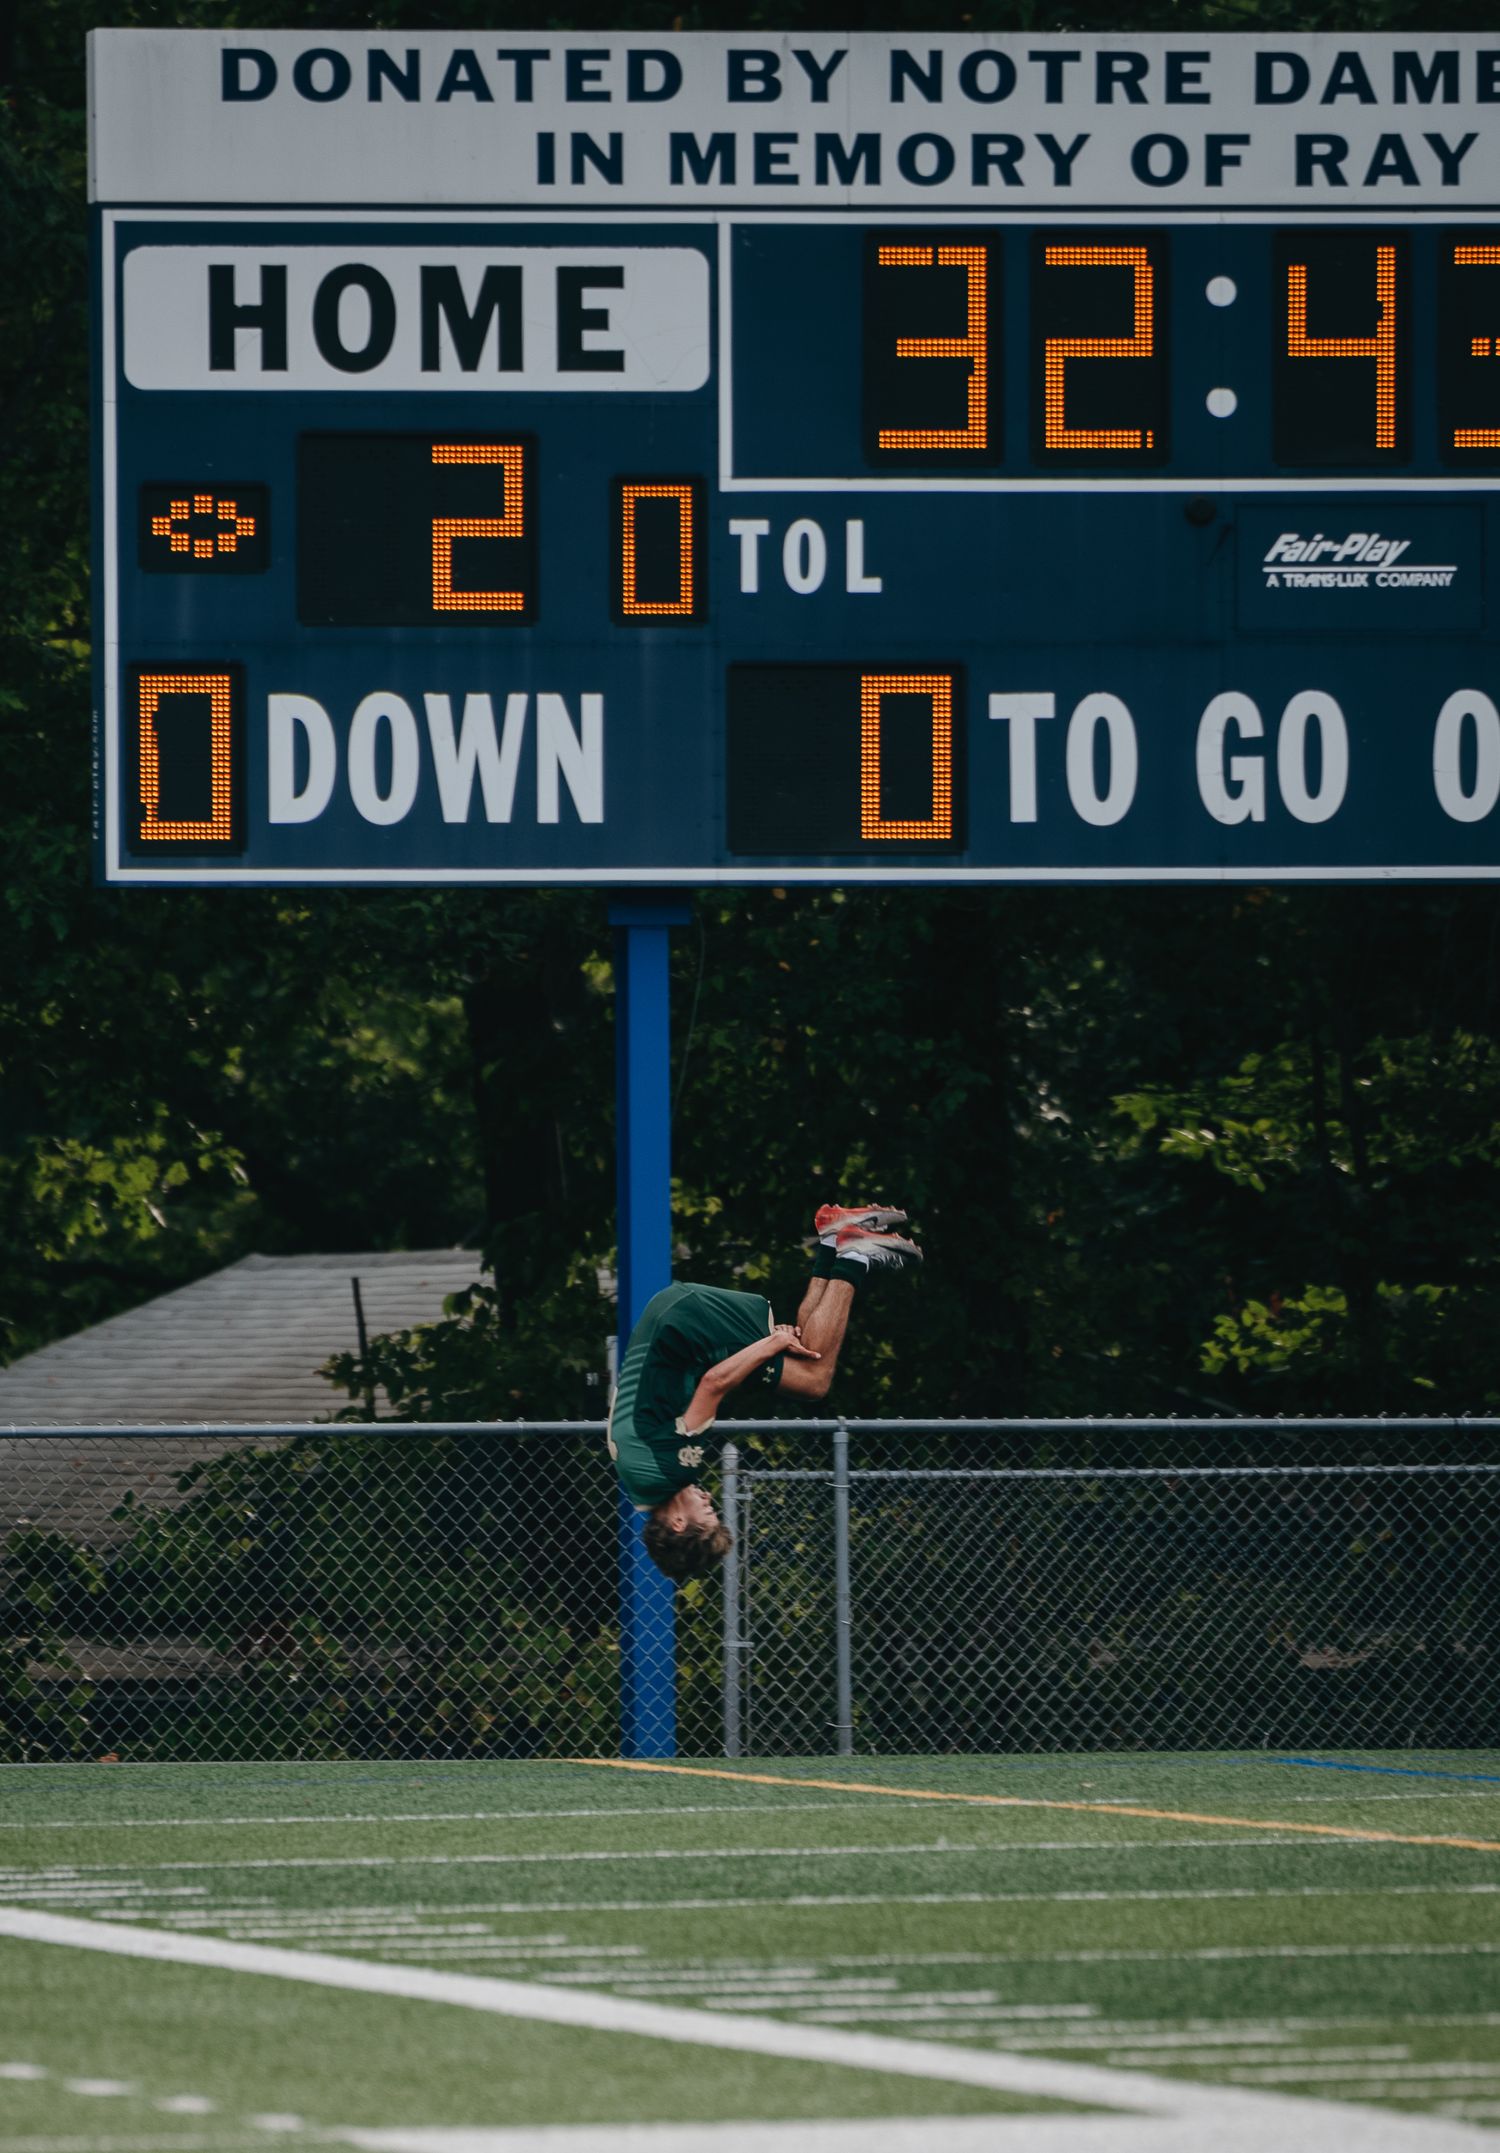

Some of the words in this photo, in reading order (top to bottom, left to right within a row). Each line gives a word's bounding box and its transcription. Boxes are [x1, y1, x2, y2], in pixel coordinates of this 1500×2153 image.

[222, 48, 682, 102] DONATED
[728, 50, 848, 102] BY
[891, 50, 1210, 104] NOTRE
[538, 132, 623, 184] IN
[670, 133, 1090, 186] MEMORY
[1131, 134, 1250, 187] OF
[1296, 133, 1478, 186] RAY
[209, 264, 624, 373] HOME
[432, 445, 524, 610] 2
[623, 486, 693, 614] 0
[729, 519, 882, 594] TOL
[1263, 533, 1411, 567] Fair-Play
[1266, 574, 1279, 587] A
[1375, 573, 1454, 587] COMPANY
[139, 675, 231, 840] 0
[268, 692, 604, 825] DOWN
[861, 675, 952, 839] 0
[989, 692, 1137, 826] TO
[1196, 690, 1348, 825] GO
